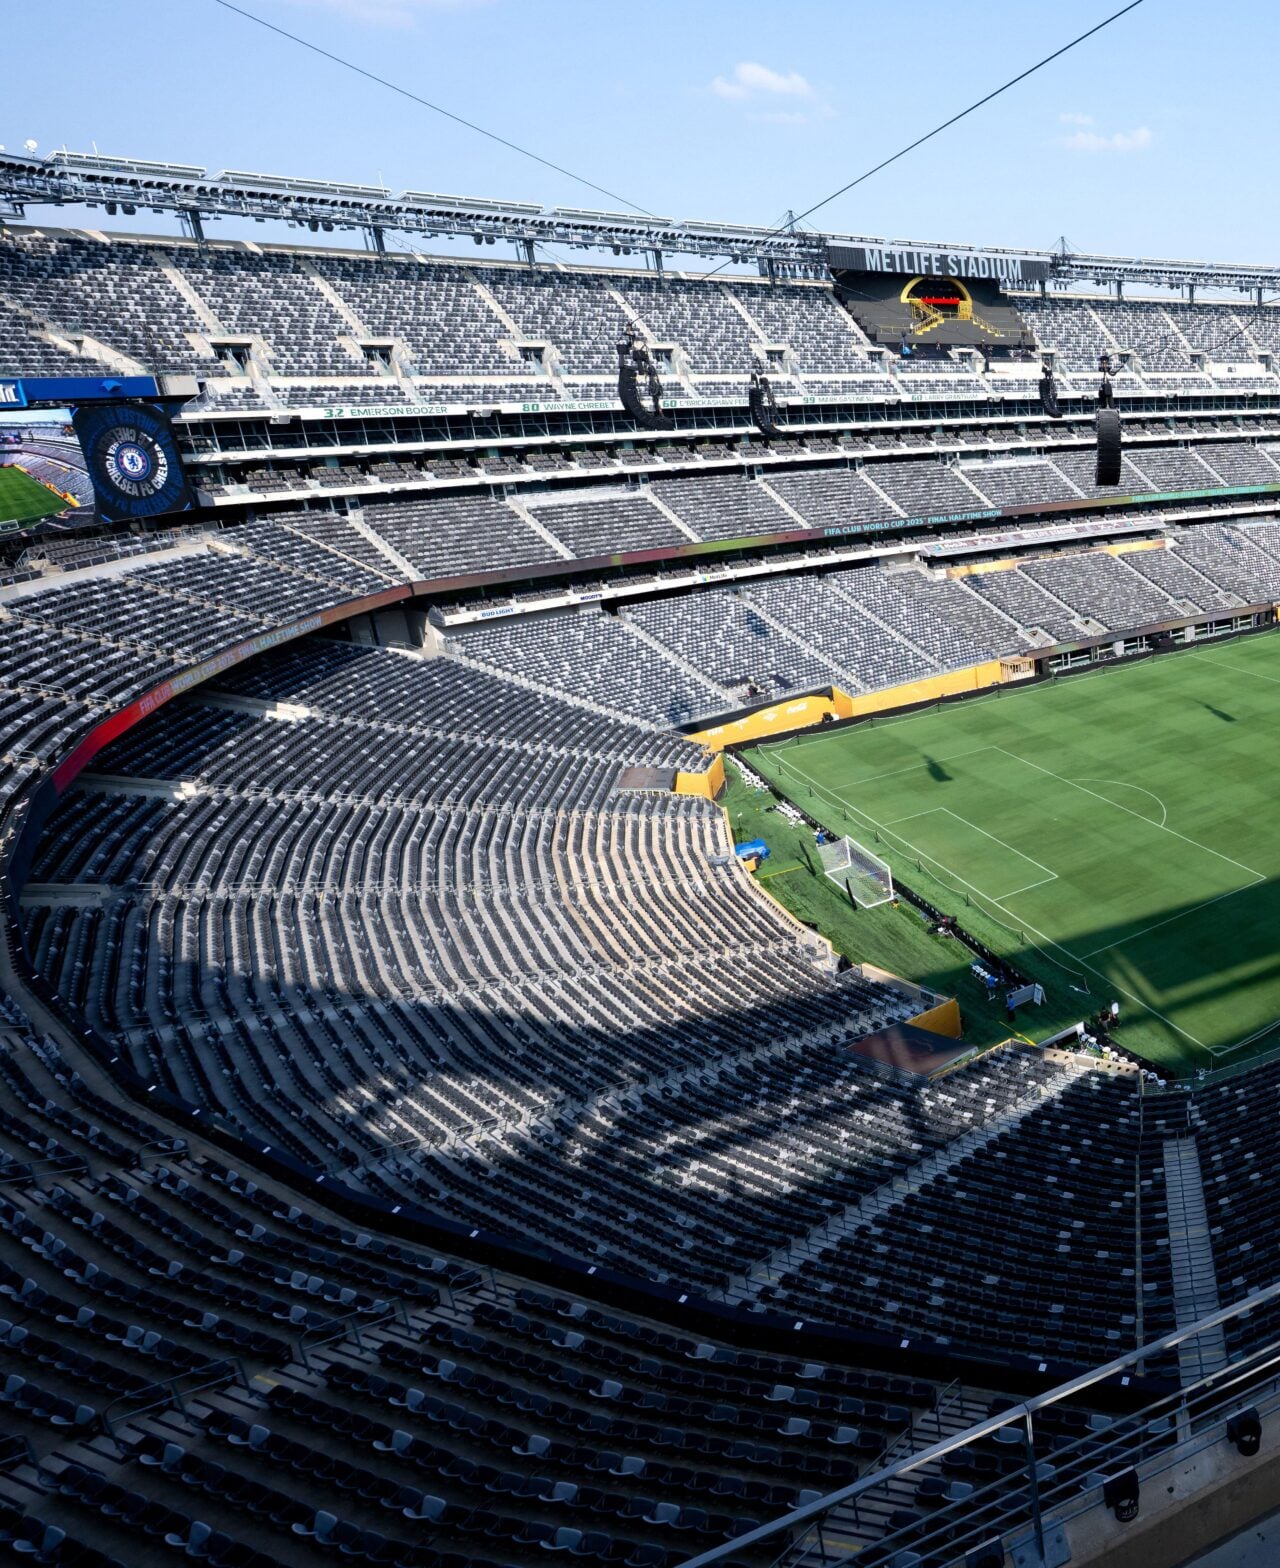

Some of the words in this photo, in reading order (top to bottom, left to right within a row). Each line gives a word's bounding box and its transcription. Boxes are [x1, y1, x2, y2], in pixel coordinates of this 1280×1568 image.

[864, 247, 943, 276] METLIFE
[947, 254, 1022, 280] STADIUM
[522, 403, 540, 412] 80
[543, 402, 576, 411] WAYNE
[577, 401, 616, 410] CHREBET
[662, 399, 678, 408] 60
[350, 407, 404, 417] EMERSON
[406, 406, 448, 415] BOOZER
[824, 527, 841, 536] FIFA
[842, 525, 861, 534] CLUB
[863, 522, 889, 532] WORLD
[890, 519, 905, 528] CUP
[927, 515, 947, 524] FINAL
[948, 511, 982, 522] HALFTIME
[983, 509, 1003, 518] SHOW
[481, 610, 495, 618] BUD
[496, 607, 514, 616] LIGHT
[139, 698, 155, 715] FIFA
[170, 670, 200, 692] WORLD
[238, 642, 258, 658] FINAL
[260, 627, 300, 648] HALFTIME
[300, 616, 322, 632] SHOW
